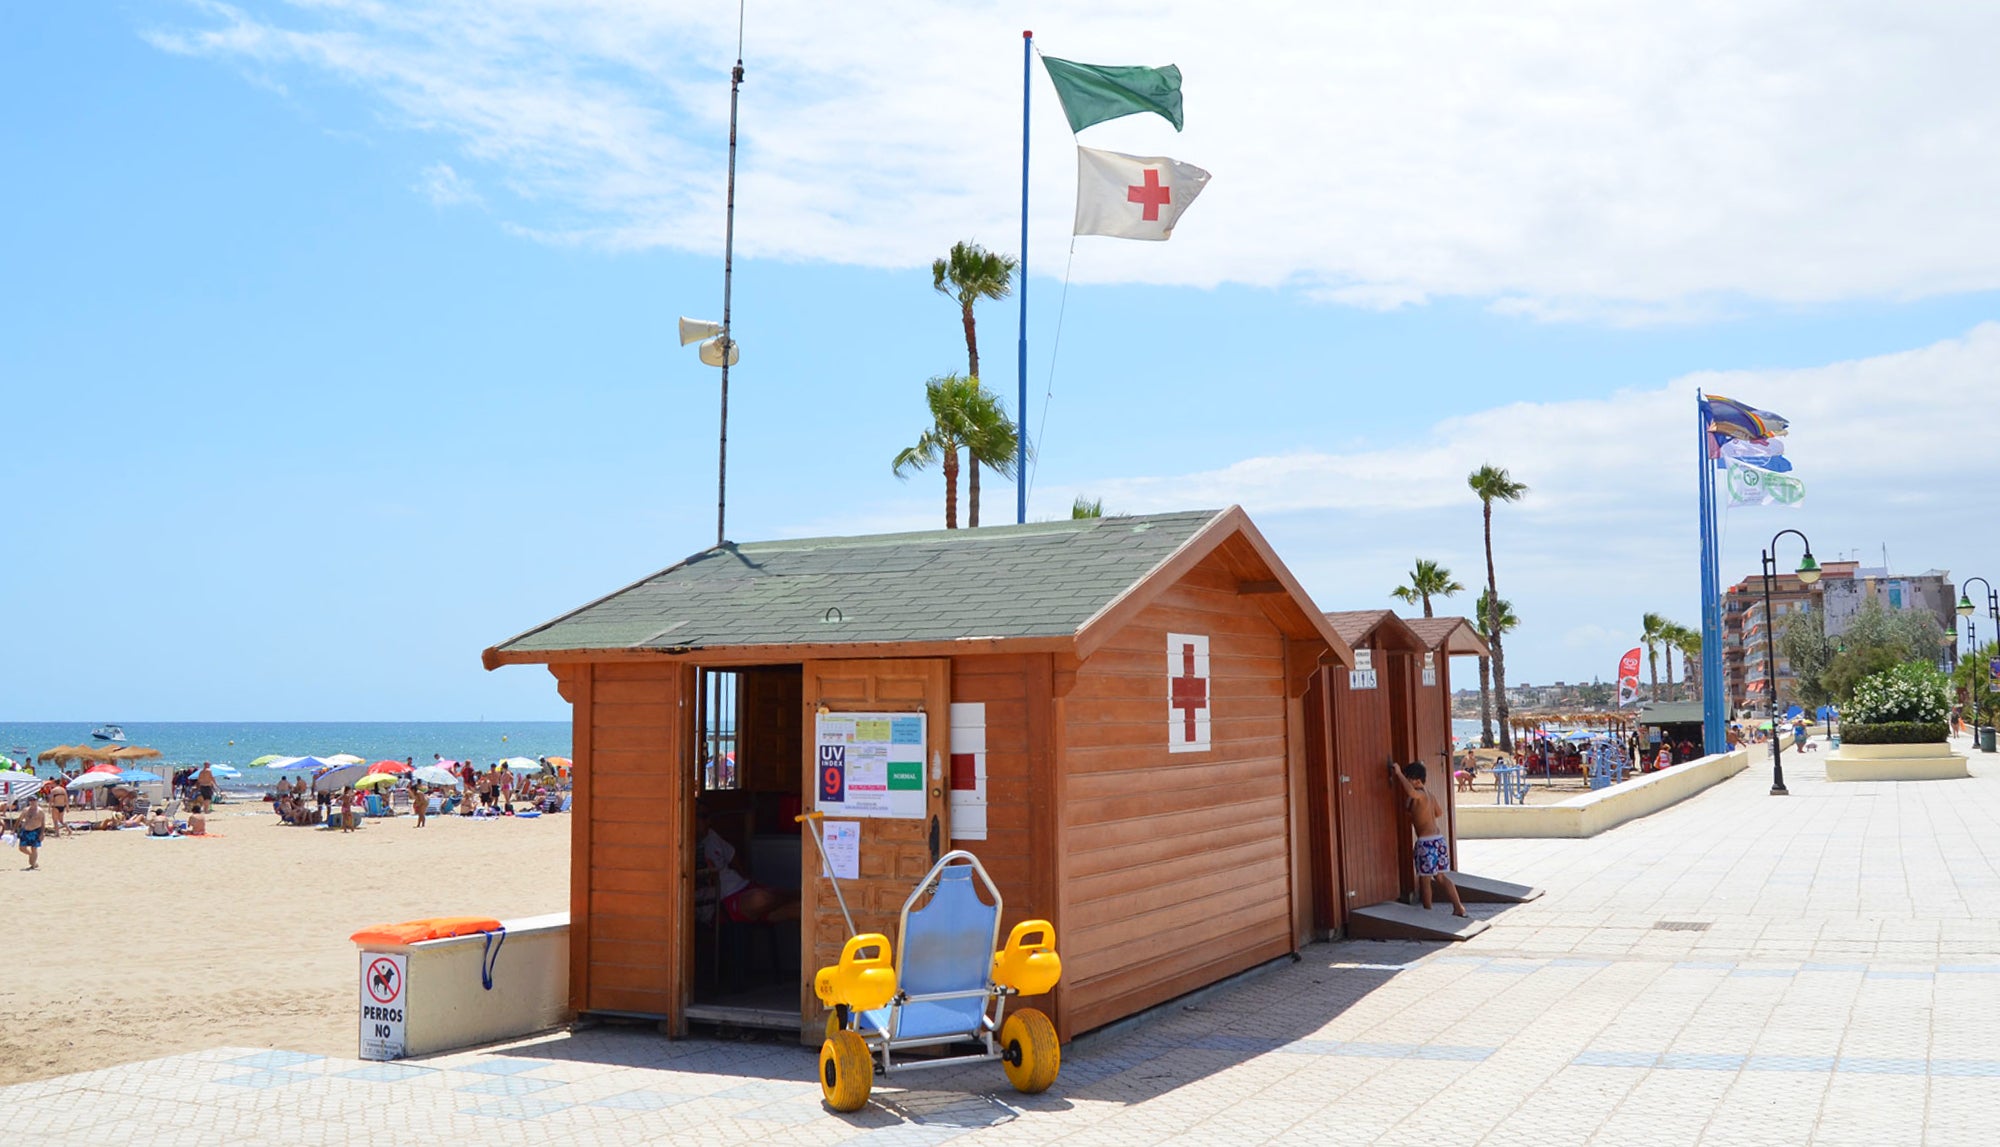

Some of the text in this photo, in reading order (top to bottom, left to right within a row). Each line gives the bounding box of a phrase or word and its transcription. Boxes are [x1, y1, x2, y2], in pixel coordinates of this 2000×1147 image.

[822, 746, 843, 760] UV
[825, 767, 840, 794] 9
[363, 1006, 403, 1022] PERROS
[375, 1024, 391, 1038] NO
